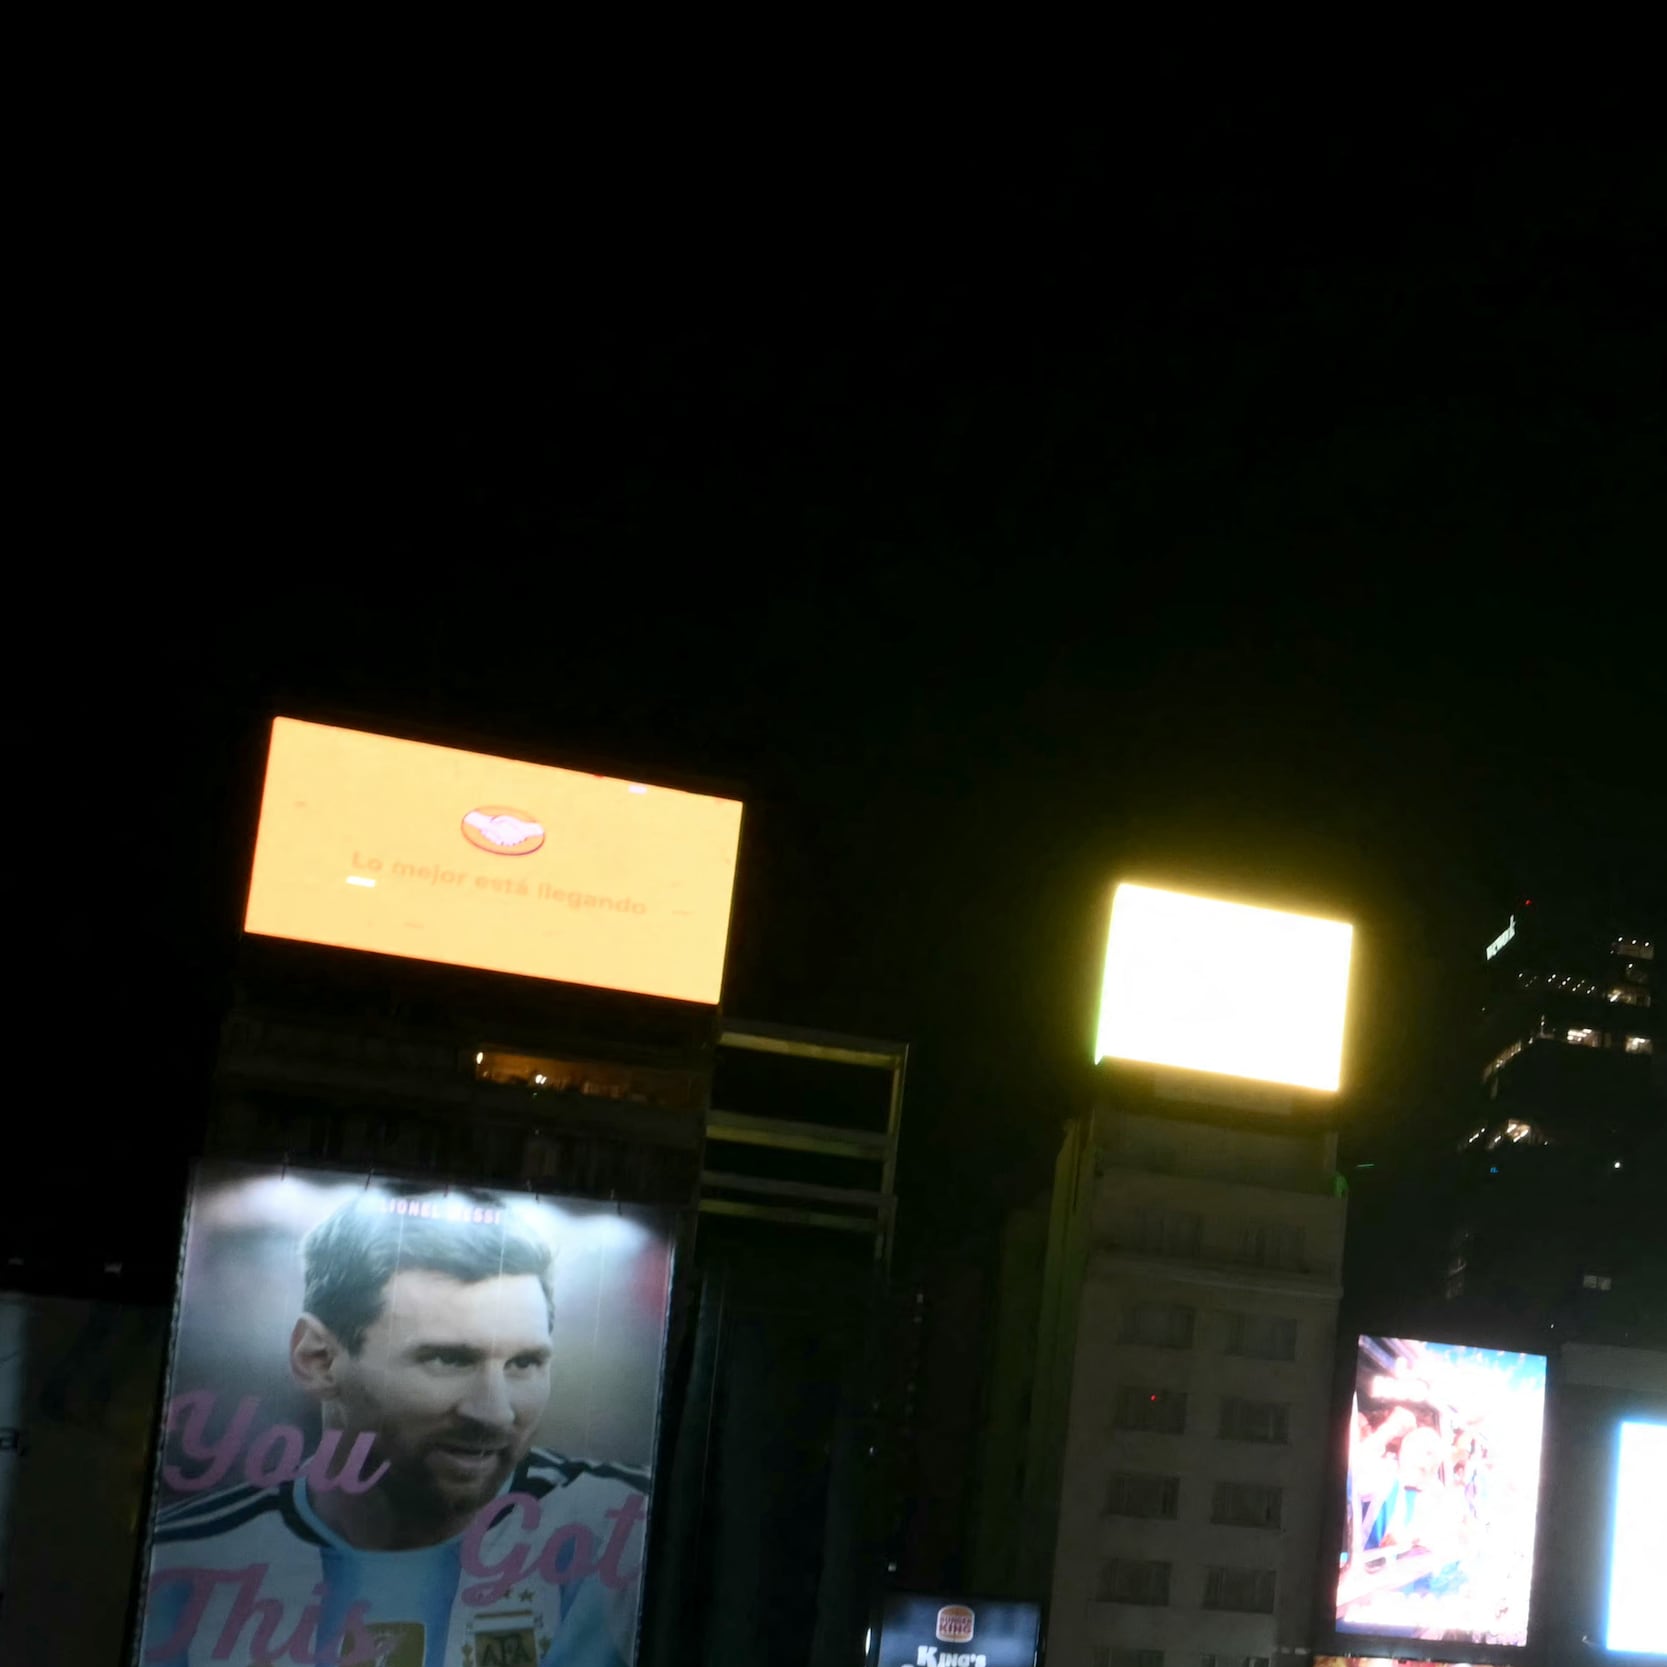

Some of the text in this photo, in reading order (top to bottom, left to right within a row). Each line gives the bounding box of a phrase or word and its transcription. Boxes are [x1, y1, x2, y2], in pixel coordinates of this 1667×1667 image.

[351, 850, 648, 916] Lo mejor está llegando
[380, 1198, 439, 1219] LIONEL
[162, 1391, 392, 1494] You
[460, 1492, 646, 1608] Got
[143, 1562, 398, 1667] This
[938, 1622, 972, 1634] KING
